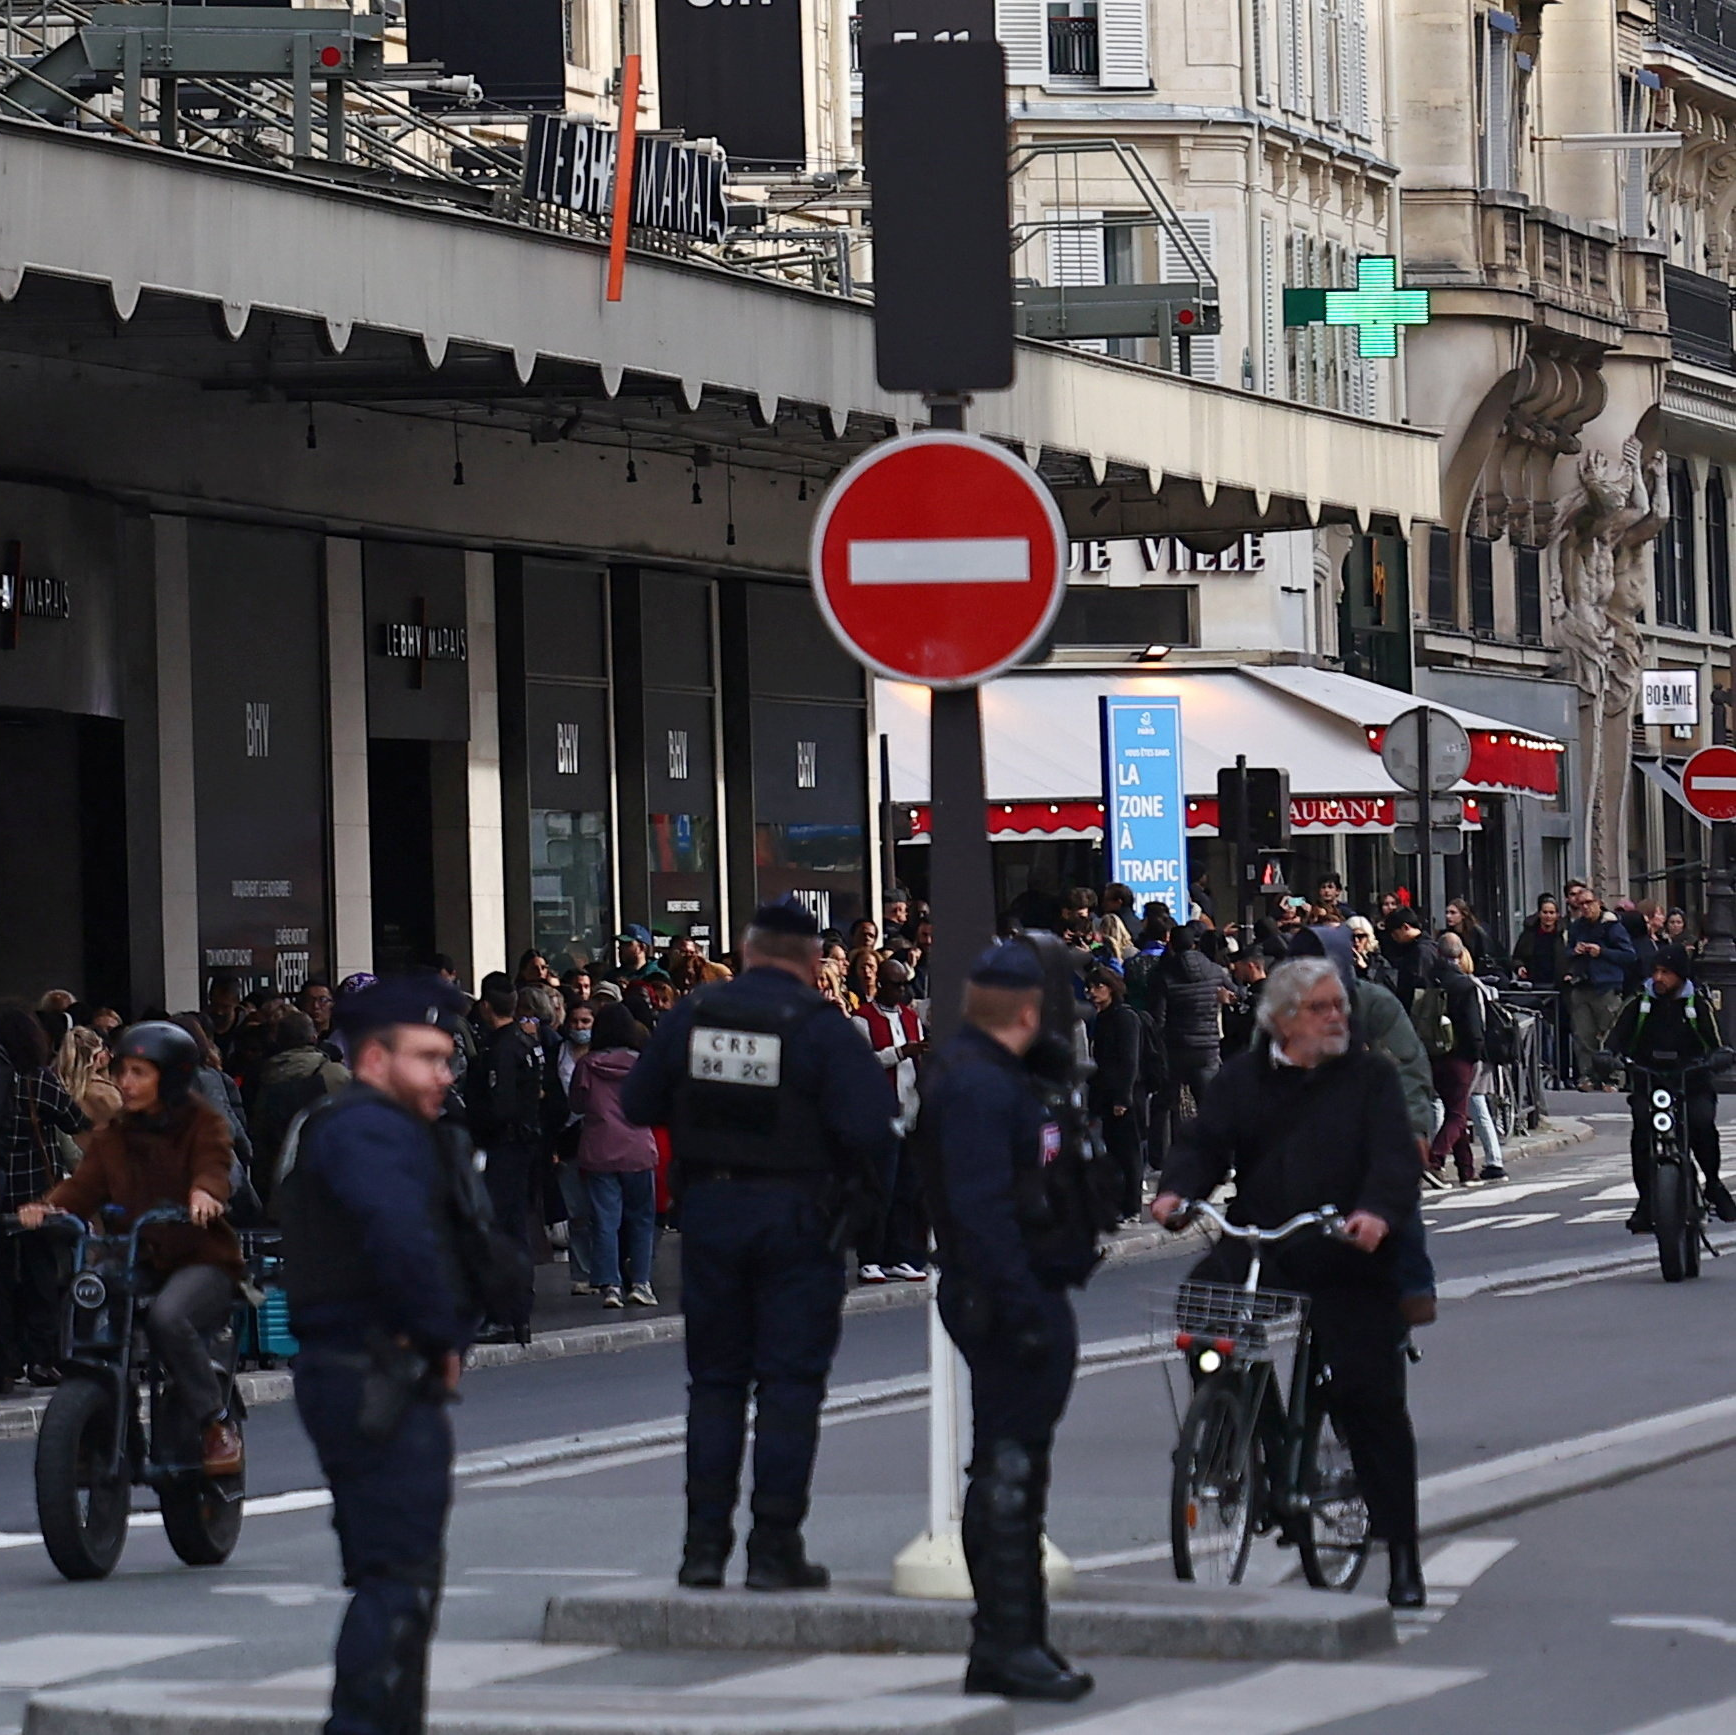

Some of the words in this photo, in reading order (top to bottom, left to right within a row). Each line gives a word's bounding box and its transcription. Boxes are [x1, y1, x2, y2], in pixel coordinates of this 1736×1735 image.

[537, 115, 568, 203] LE
[636, 136, 729, 244] MARAIS
[23, 578, 70, 619] MARAIS
[386, 624, 399, 657] LE
[400, 624, 422, 659] BHV
[246, 702, 270, 757] BHV
[557, 723, 579, 774] BHV
[668, 730, 688, 779] BHV
[797, 741, 816, 788] BHV
[1118, 764, 1140, 785] LA
[1119, 795, 1164, 818] ZONE
[1120, 822, 1134, 850] À
[1121, 859, 1179, 882] TRAFIC
[276, 952, 309, 993] OFFERT
[712, 1036, 757, 1055] CRS
